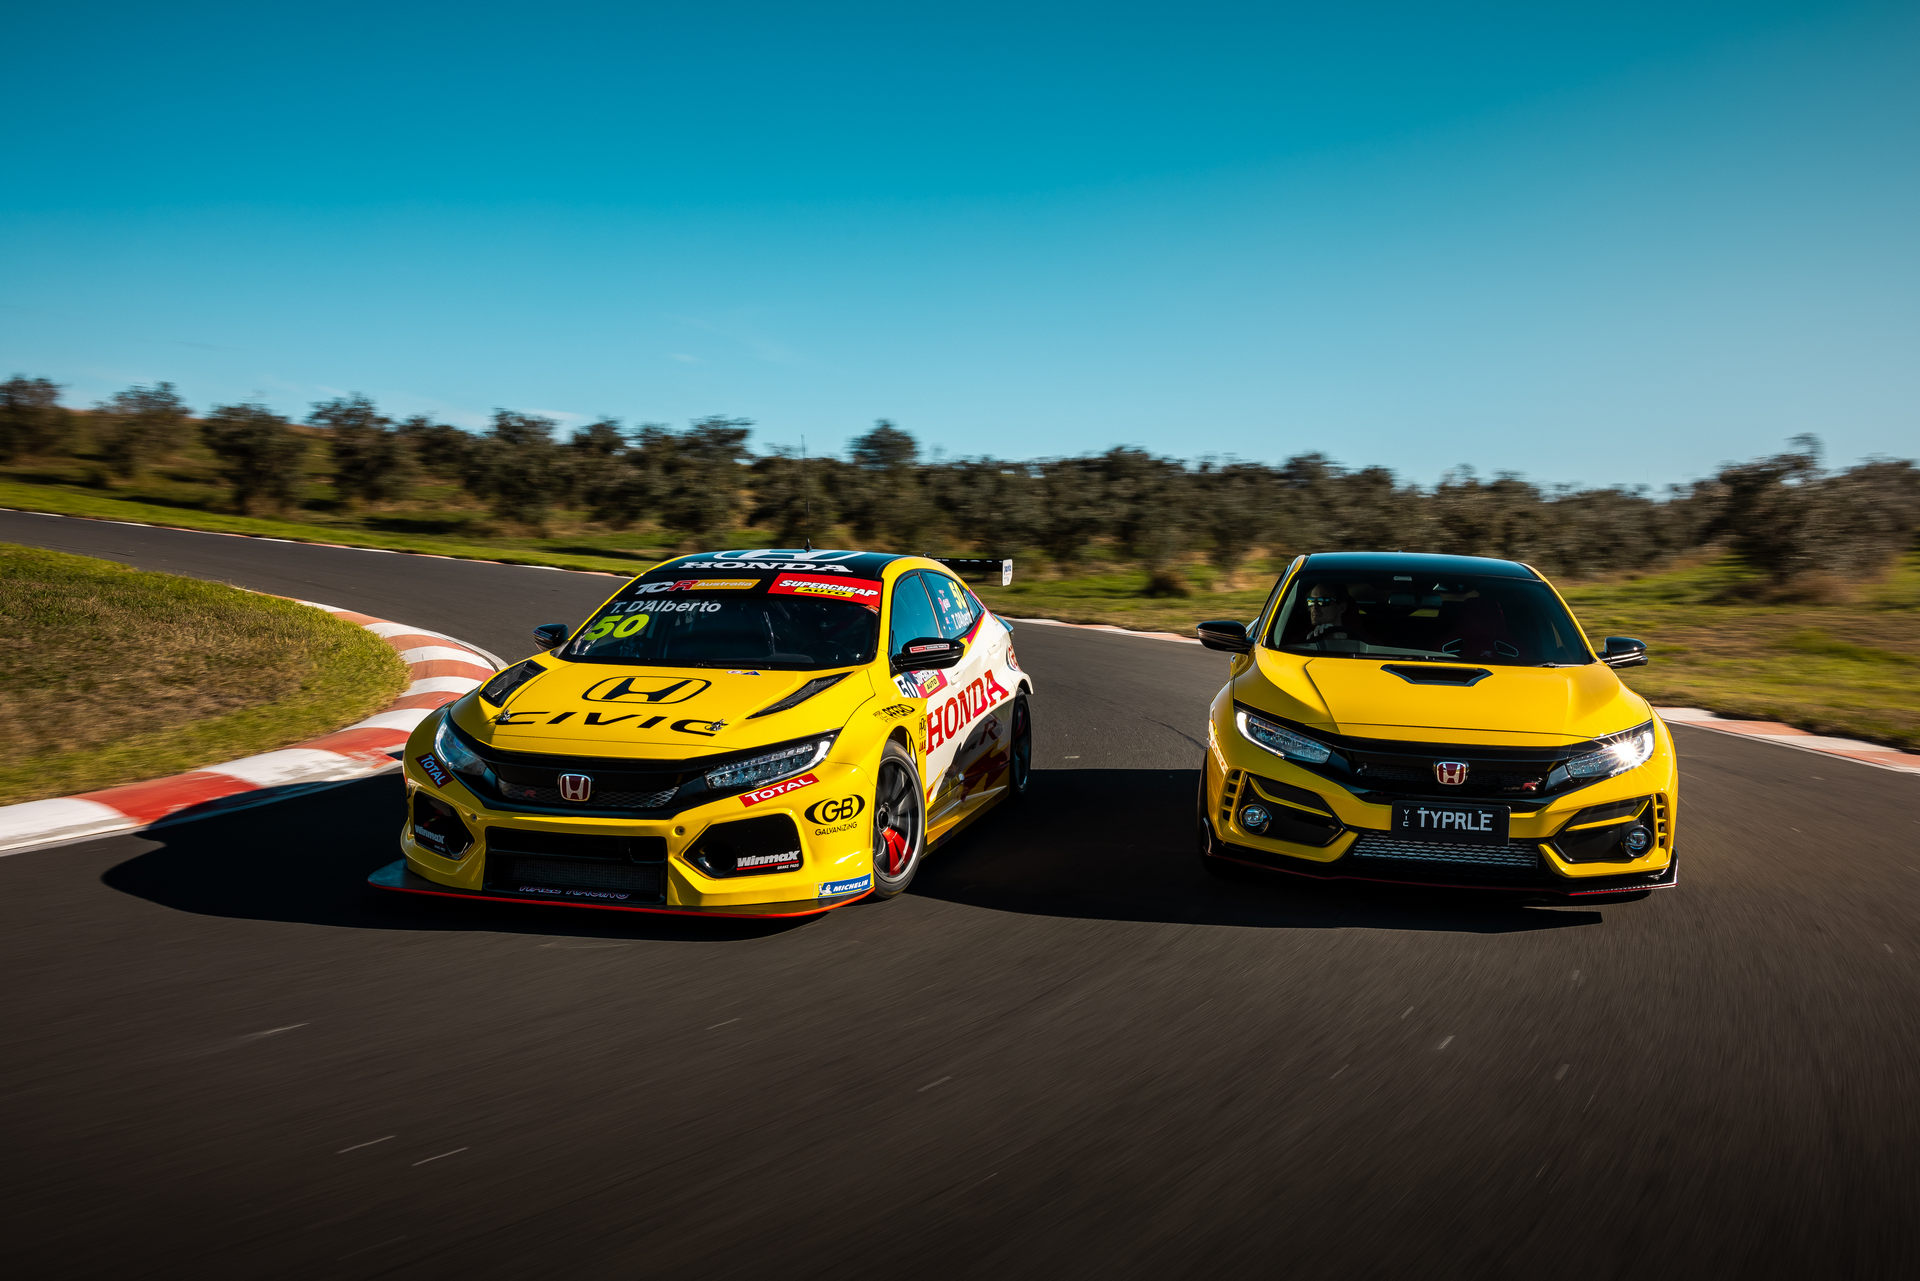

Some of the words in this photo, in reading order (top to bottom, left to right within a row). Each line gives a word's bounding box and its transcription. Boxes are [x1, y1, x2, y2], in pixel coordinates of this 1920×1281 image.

[678, 561, 853, 573] HONDA
[635, 580, 699, 595] TCR
[779, 580, 879, 597] SUPERCHEAP
[803, 588, 846, 596] AUTO
[610, 601, 626, 614] T.
[624, 600, 722, 613] D'Alberto
[584, 613, 650, 641] 50
[926, 669, 1009, 755] HONDA
[495, 711, 728, 737] CIVIC
[420, 754, 446, 786] TOTAL
[745, 778, 813, 802] TOTAL
[822, 797, 853, 823] GB
[1402, 809, 1411, 828] VIC
[815, 821, 857, 837] GALVANIZING
[1417, 810, 1494, 832] TYPRLE
[833, 879, 869, 893] MICHELIN
